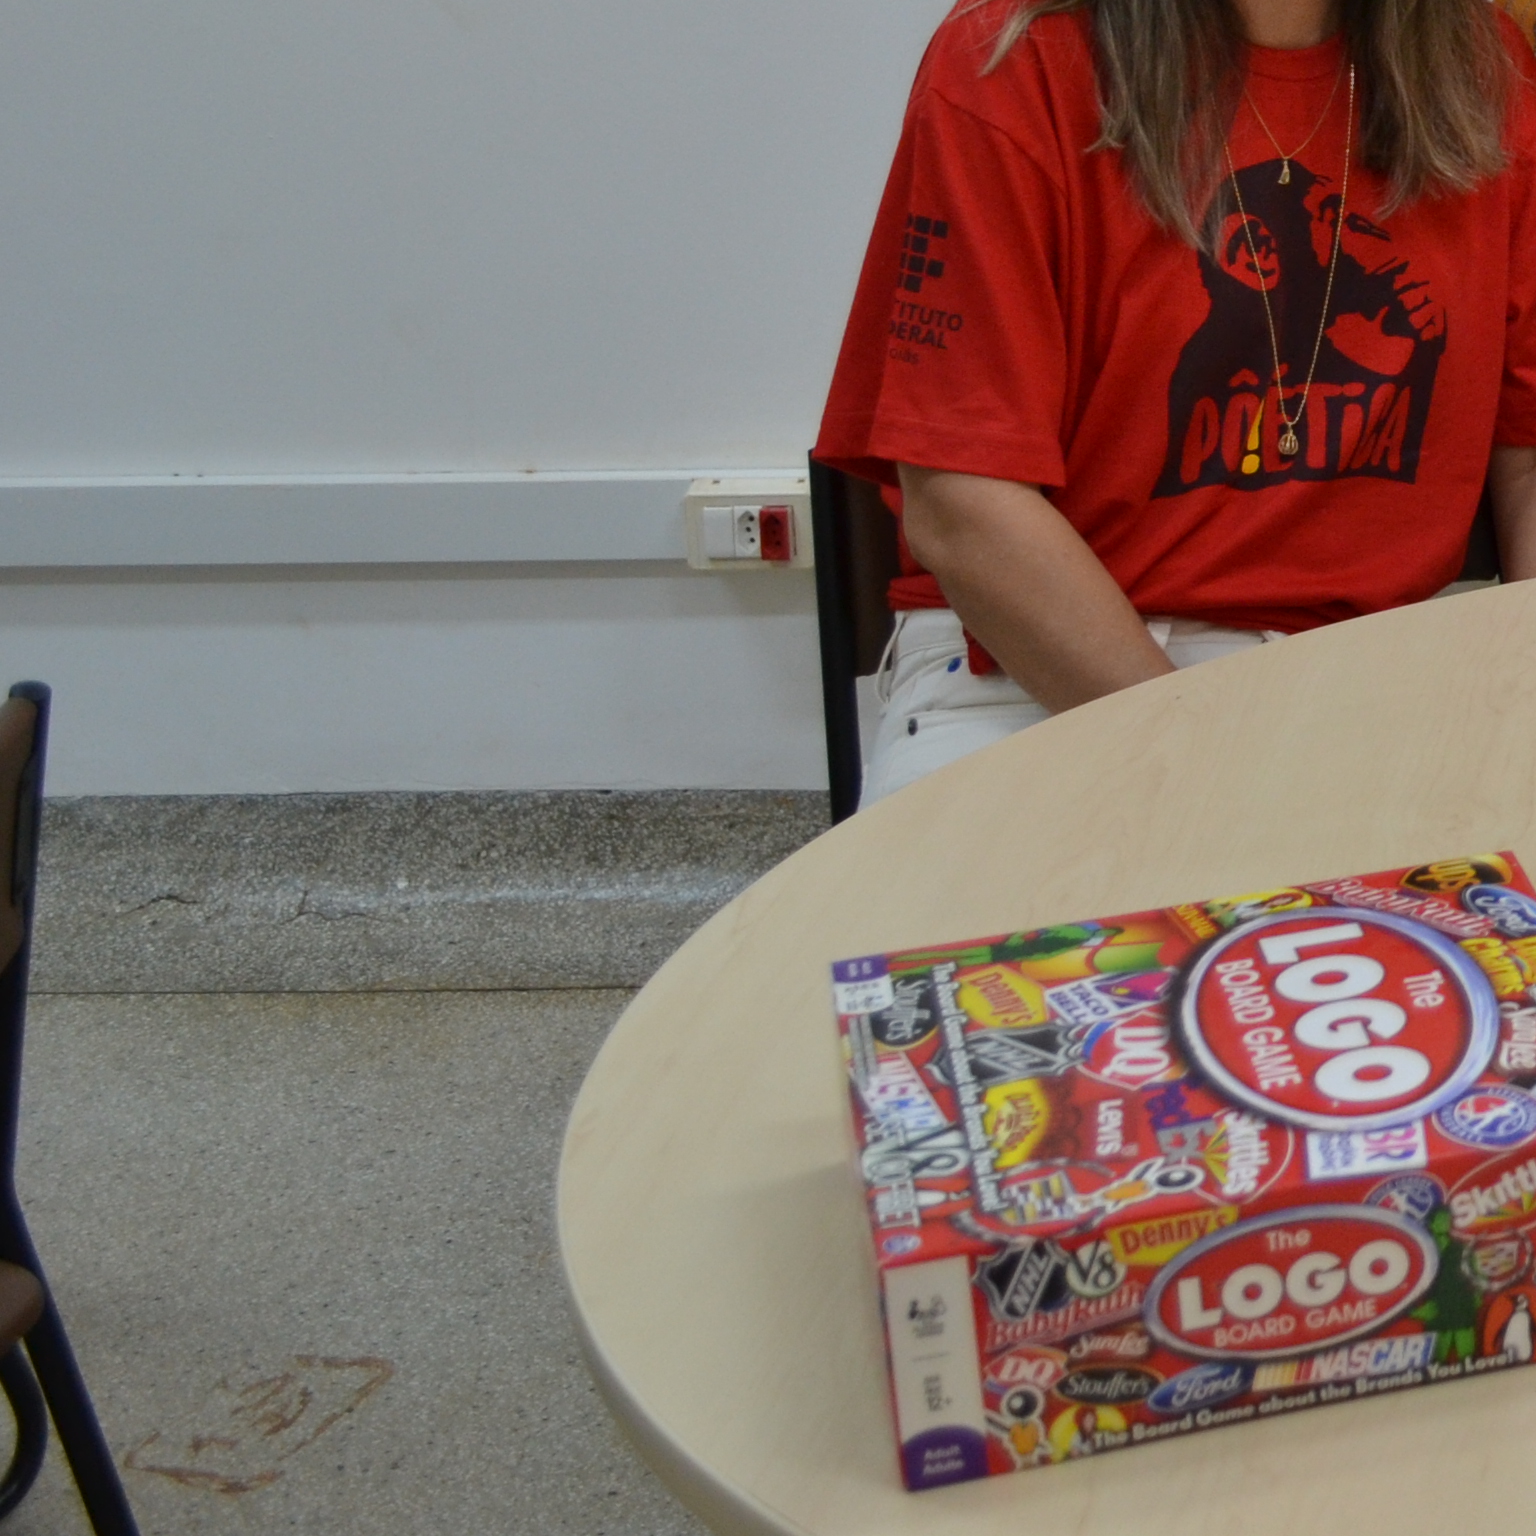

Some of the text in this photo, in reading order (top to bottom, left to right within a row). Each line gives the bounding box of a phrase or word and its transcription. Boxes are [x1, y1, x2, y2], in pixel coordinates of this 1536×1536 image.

[1070, 983, 1108, 1016] TACO
[1259, 923, 1431, 1102] LOGO
[1404, 971, 1445, 1009] The
[1215, 958, 1304, 1091] BOARD GAME
[1106, 1025, 1170, 1081] DQ
[1222, 1109, 1271, 1197] Skittles
[1071, 1241, 1119, 1291] V8
[1266, 1229, 1313, 1253] The
[1010, 1242, 1051, 1317] NHL
[1177, 1238, 1411, 1333] LOGO
[1213, 1297, 1377, 1349] BOARD GAME
[998, 1356, 1056, 1383] DQ
[1309, 1334, 1430, 1381] NASCAR
[1063, 1372, 1150, 1400] Stouffer's
[1094, 1428, 1129, 1450] The
[1131, 1412, 1194, 1442] Board
[1195, 1401, 1255, 1427] Game
[1258, 1389, 1315, 1414] about
[1319, 1382, 1352, 1403] the
[1354, 1369, 1424, 1396] Brands
[1426, 1360, 1462, 1382] You
[1171, 1367, 1243, 1407] Ford
